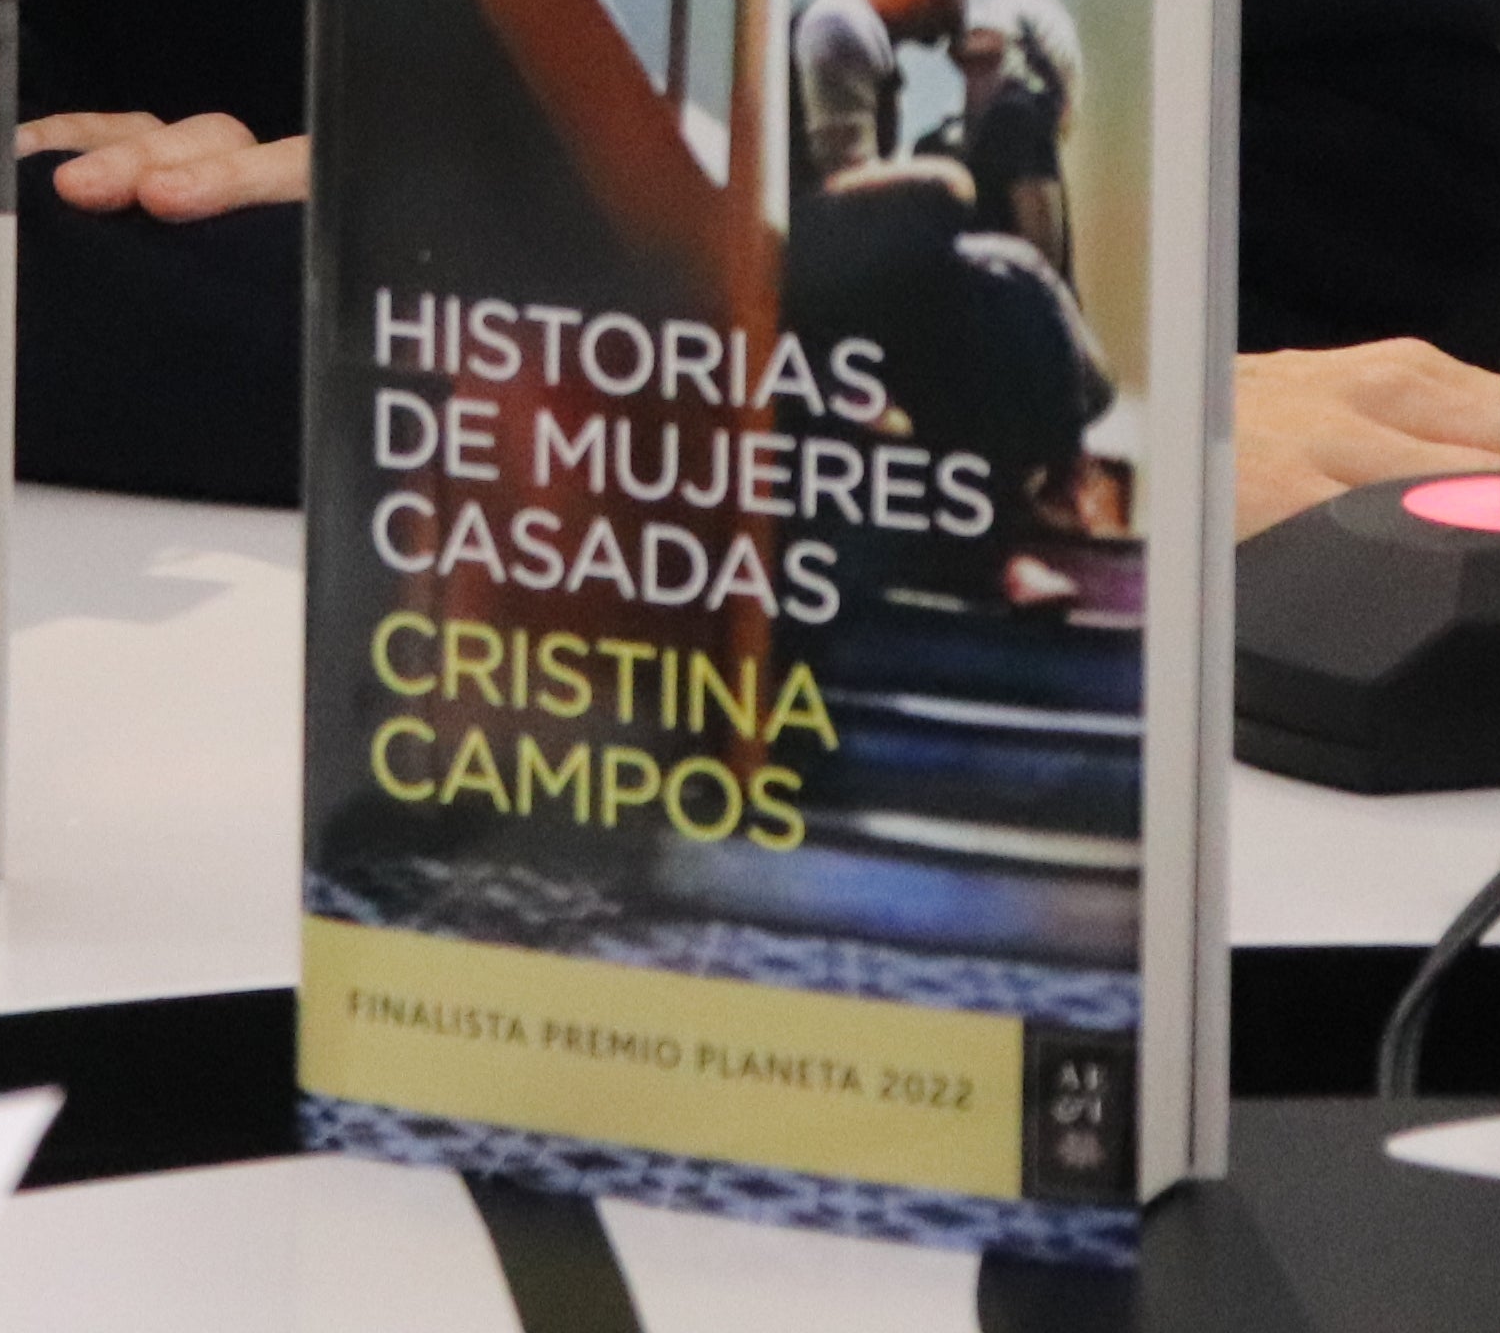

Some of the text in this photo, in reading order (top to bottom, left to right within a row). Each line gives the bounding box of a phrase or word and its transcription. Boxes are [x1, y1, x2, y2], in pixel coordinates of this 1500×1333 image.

[373, 287, 889, 423] HISTORIAS
[374, 389, 993, 537] DE MUJERES
[372, 493, 841, 624] CASADAS
[371, 612, 840, 751] CRISTINA
[371, 719, 807, 851] CAMPOS
[347, 987, 975, 1112] FINALISTA PREMIO PLANETA 2022
